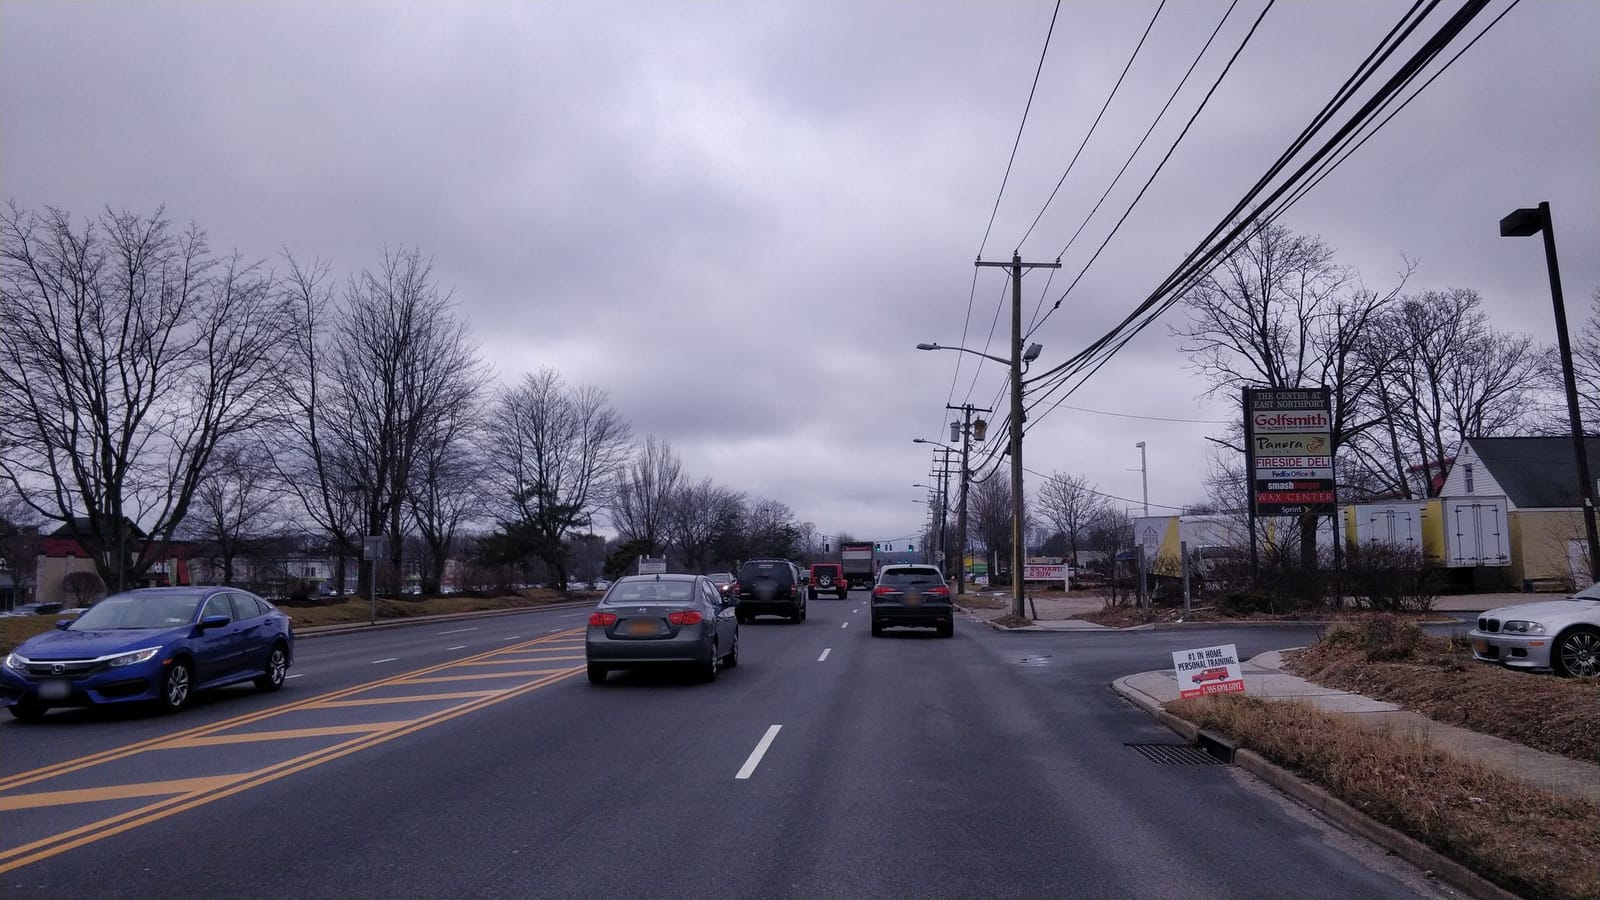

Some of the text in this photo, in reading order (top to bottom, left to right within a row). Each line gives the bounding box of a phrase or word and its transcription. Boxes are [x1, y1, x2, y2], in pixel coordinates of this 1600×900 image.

[1257, 392, 1321, 400] THE CENTER AT
[1254, 400, 1325, 409] EAST NORTHPORT
[1255, 413, 1327, 426] Golfsmith
[1256, 437, 1303, 450] Panera
[1257, 458, 1330, 467] FIRESIDE DELI
[1258, 493, 1332, 501] WAX CENTER
[1197, 651, 1204, 659] IN
[1206, 649, 1222, 658] HOME
[1178, 661, 1207, 671] PERSONAL
